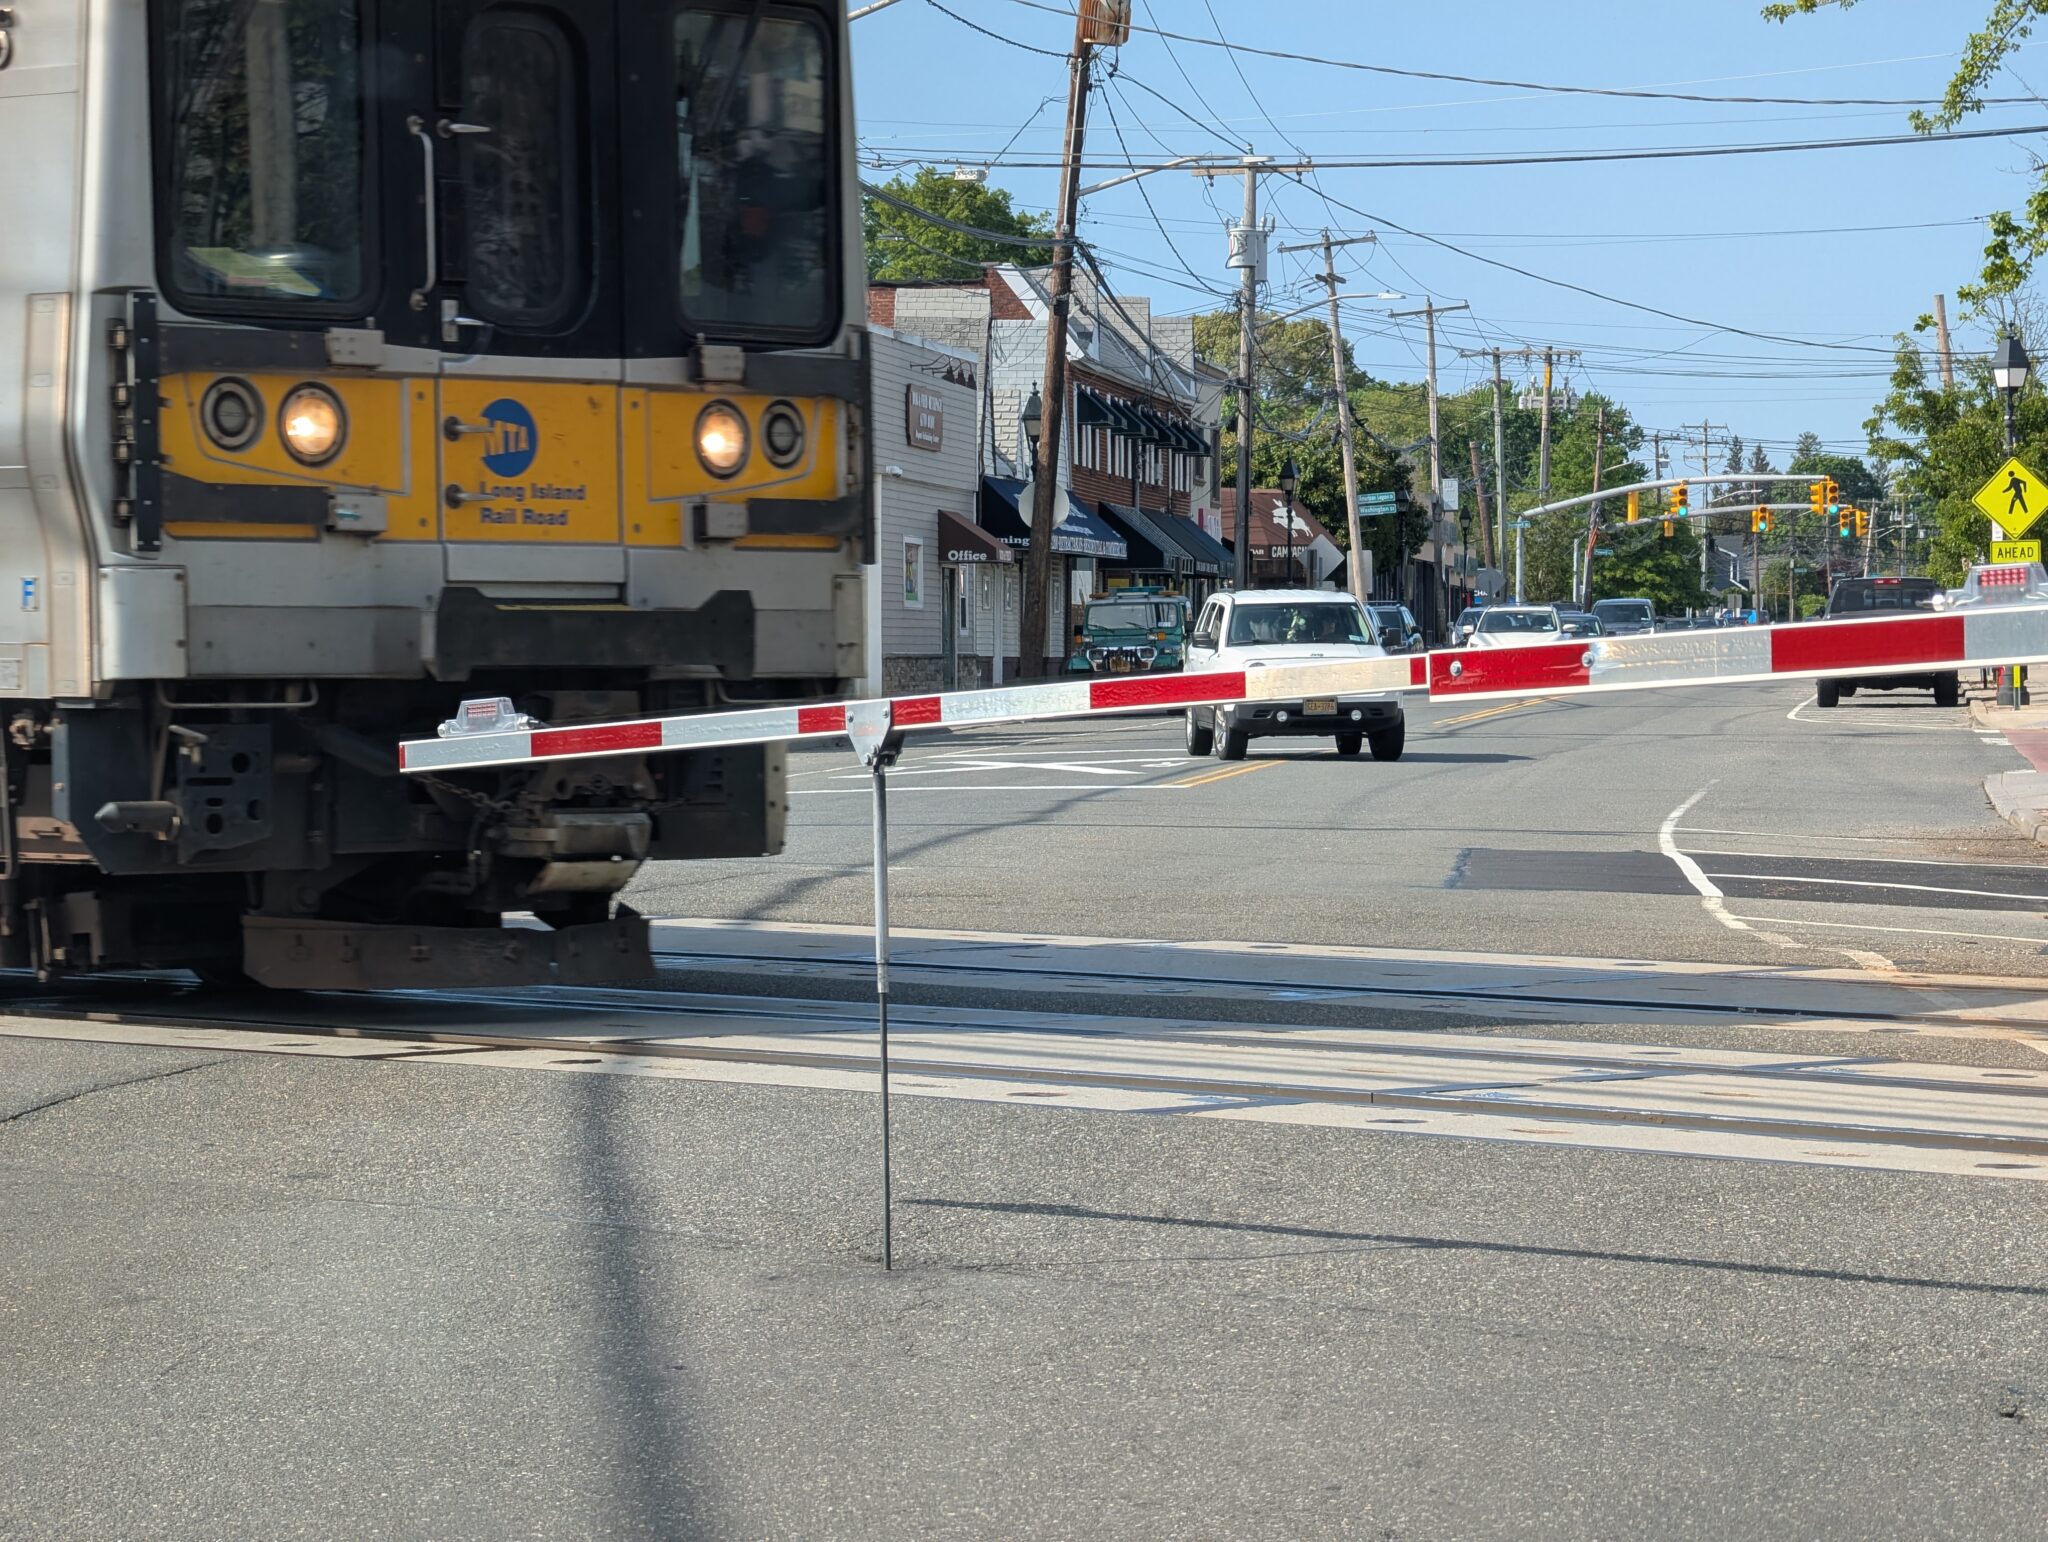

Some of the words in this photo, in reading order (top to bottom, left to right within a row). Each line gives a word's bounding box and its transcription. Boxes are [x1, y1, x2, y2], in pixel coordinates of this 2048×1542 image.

[482, 418, 529, 456] MTA
[480, 481, 525, 502] Long
[530, 483, 586, 500] Island
[481, 506, 516, 524] Rail
[522, 508, 568, 525] Road
[1360, 505, 1390, 513] Washington
[997, 536, 1031, 547] ning
[947, 550, 987, 561] Office
[1997, 547, 2034, 559] AHEAD
[22, 580, 34, 607] F
